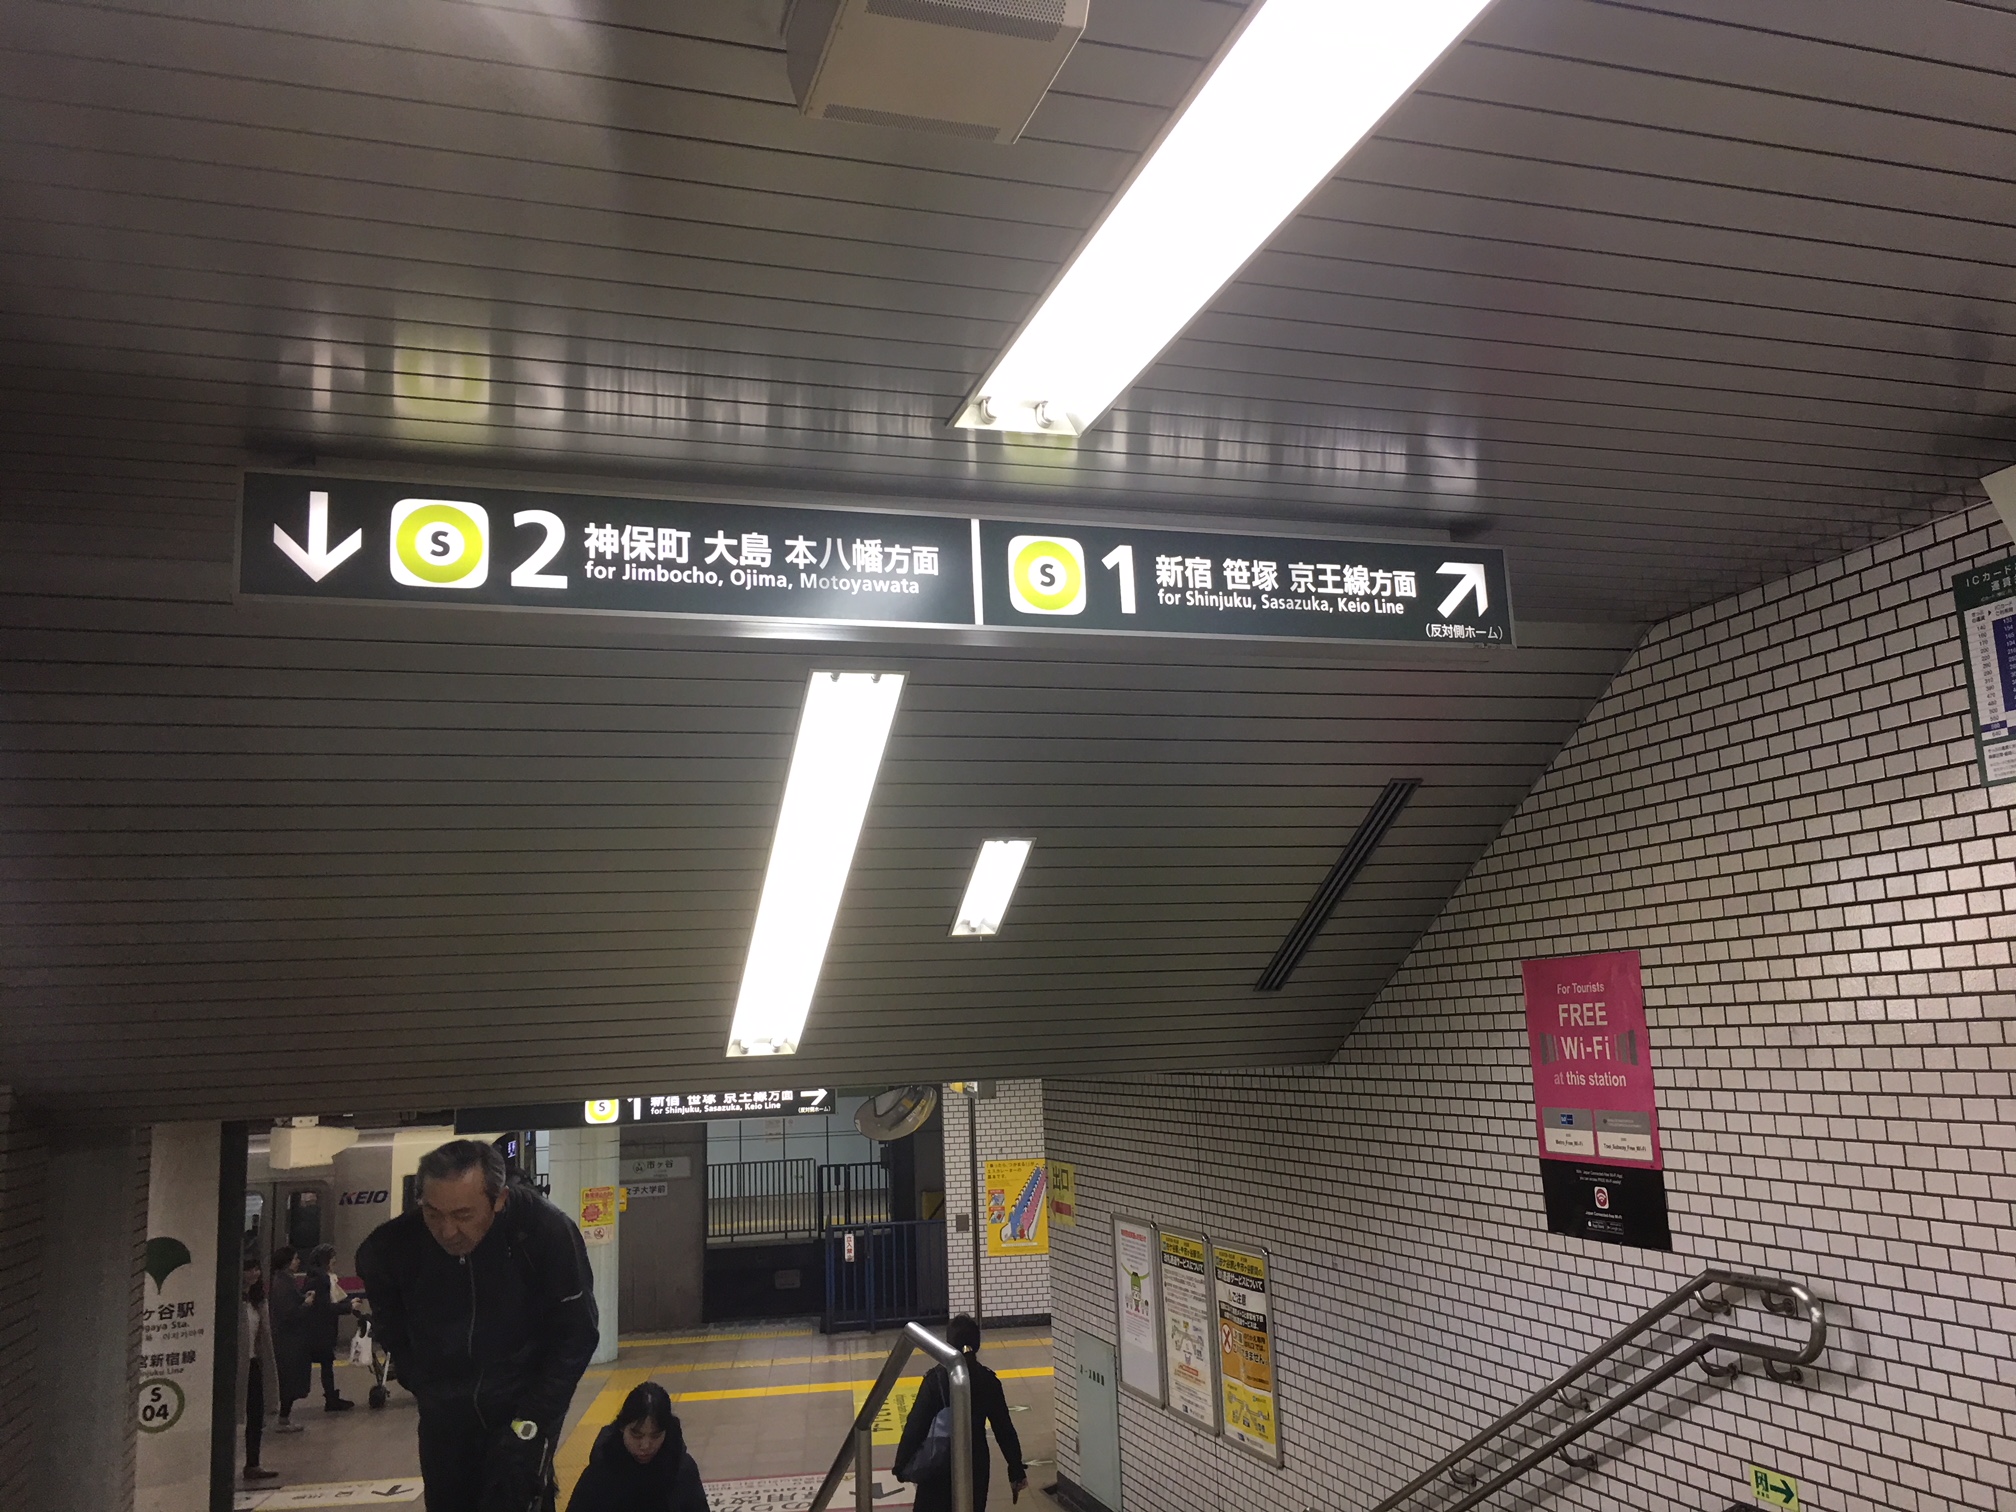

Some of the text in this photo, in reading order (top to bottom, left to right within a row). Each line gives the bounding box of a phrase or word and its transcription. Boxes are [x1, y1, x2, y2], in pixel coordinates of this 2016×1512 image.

[430, 530, 450, 557] S
[511, 509, 568, 589] 2
[584, 522, 939, 576] 神保町 大島 本八幡方面
[584, 561, 920, 595] for Jimbocho, Ojima, Motoyawata
[1040, 563, 1056, 587] S
[1101, 544, 1136, 614] 1
[1155, 554, 1417, 598] 新宿 笹塚 京王線方面
[1158, 588, 1405, 615] for Shinjuku, Sasazuka, Keio Line
[1557, 982, 1605, 994] For Tourists
[1558, 1002, 1608, 1026] FREE
[1561, 1036, 1610, 1060] Wi-Fi
[1554, 1071, 1627, 1087] at this station
[599, 1102, 605, 1111] S
[627, 1098, 641, 1120] 1
[651, 1101, 781, 1115] for Shinjuku, Sasazuka, Keio Line
[1053, 1165, 1069, 1191] 出口
[339, 1191, 388, 1205] KEIO
[151, 1387, 162, 1402] S
[142, 1404, 169, 1421] 04
